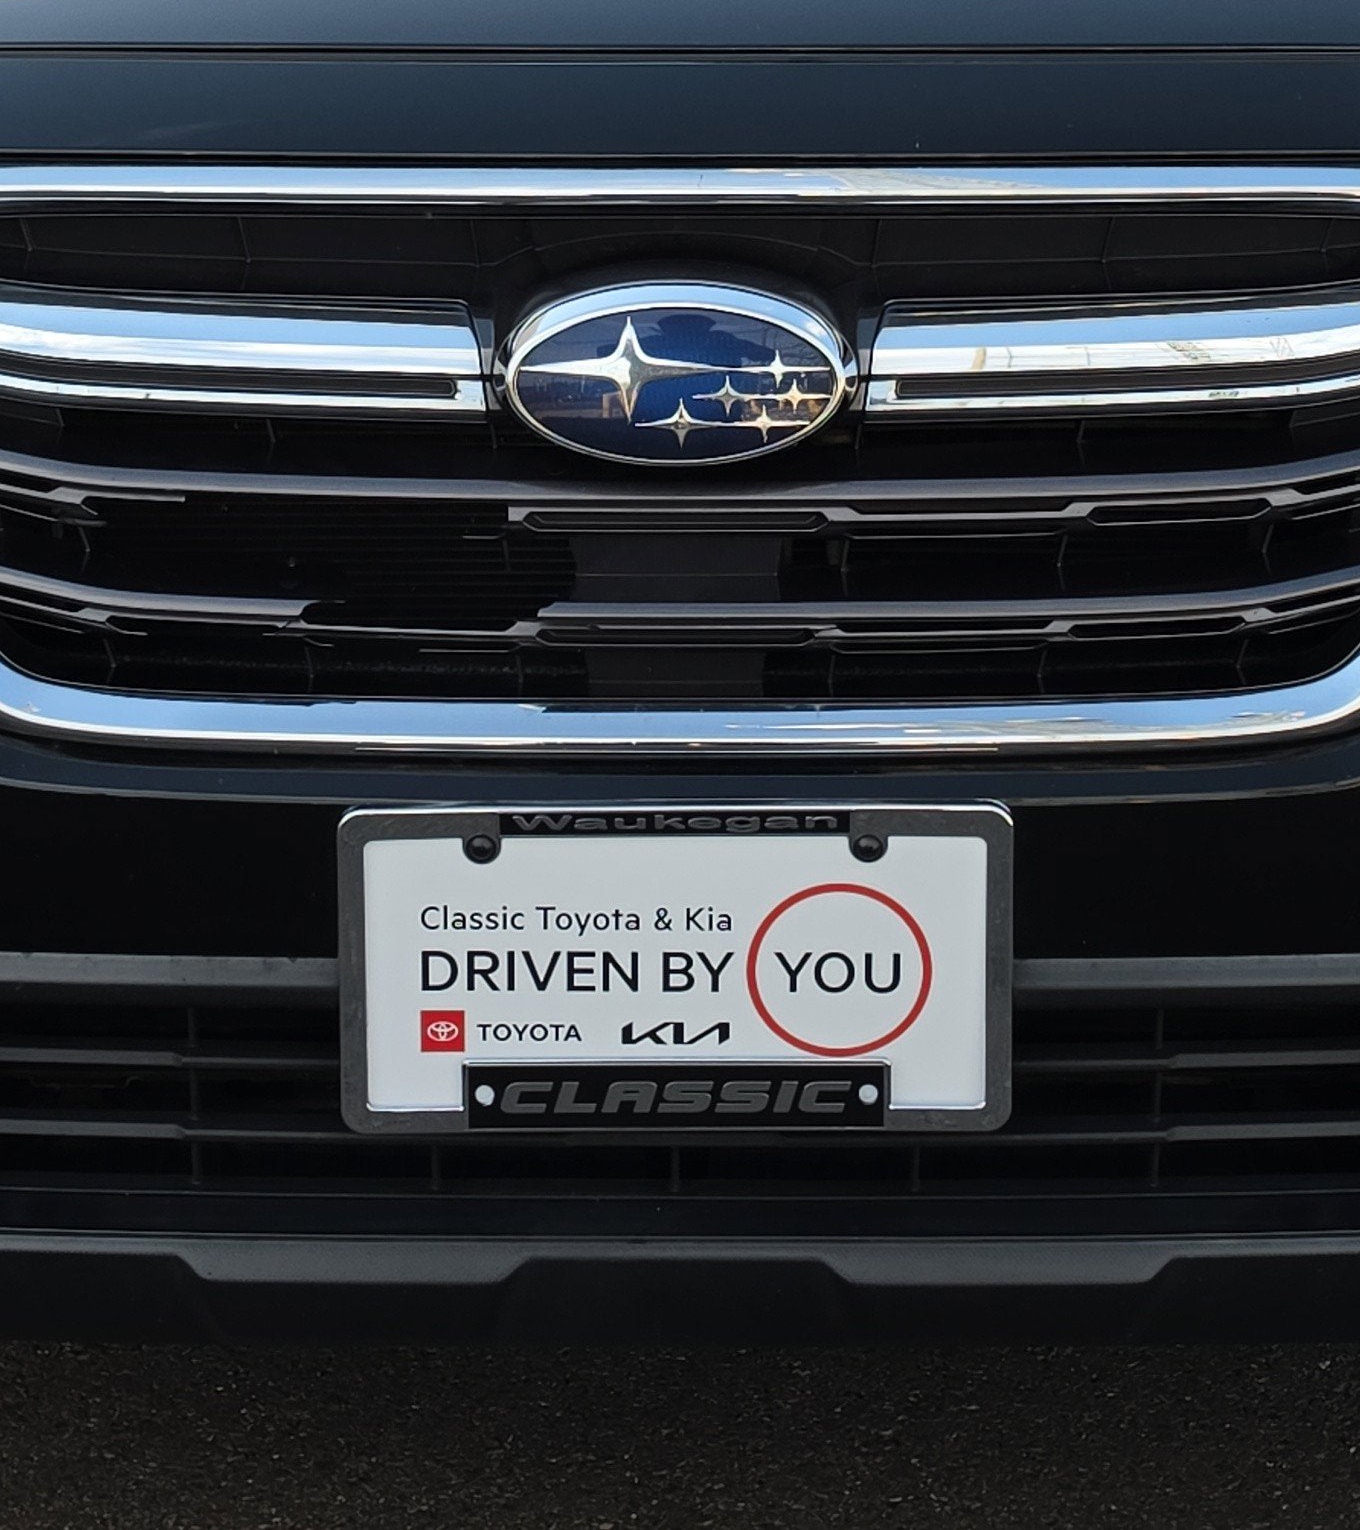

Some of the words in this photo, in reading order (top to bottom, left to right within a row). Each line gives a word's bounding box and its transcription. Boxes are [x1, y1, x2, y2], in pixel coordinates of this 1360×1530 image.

[512, 814, 838, 833] Waukegan
[420, 904, 526, 932] Classic
[535, 906, 641, 937] Toyota
[653, 907, 674, 932] &
[685, 906, 733, 932] Kia
[420, 950, 640, 993] DRIVEN
[661, 951, 735, 993] BY
[773, 951, 902, 994] YOU
[476, 1023, 583, 1043] TOYOTA
[499, 1080, 853, 1115] CLASSIC
